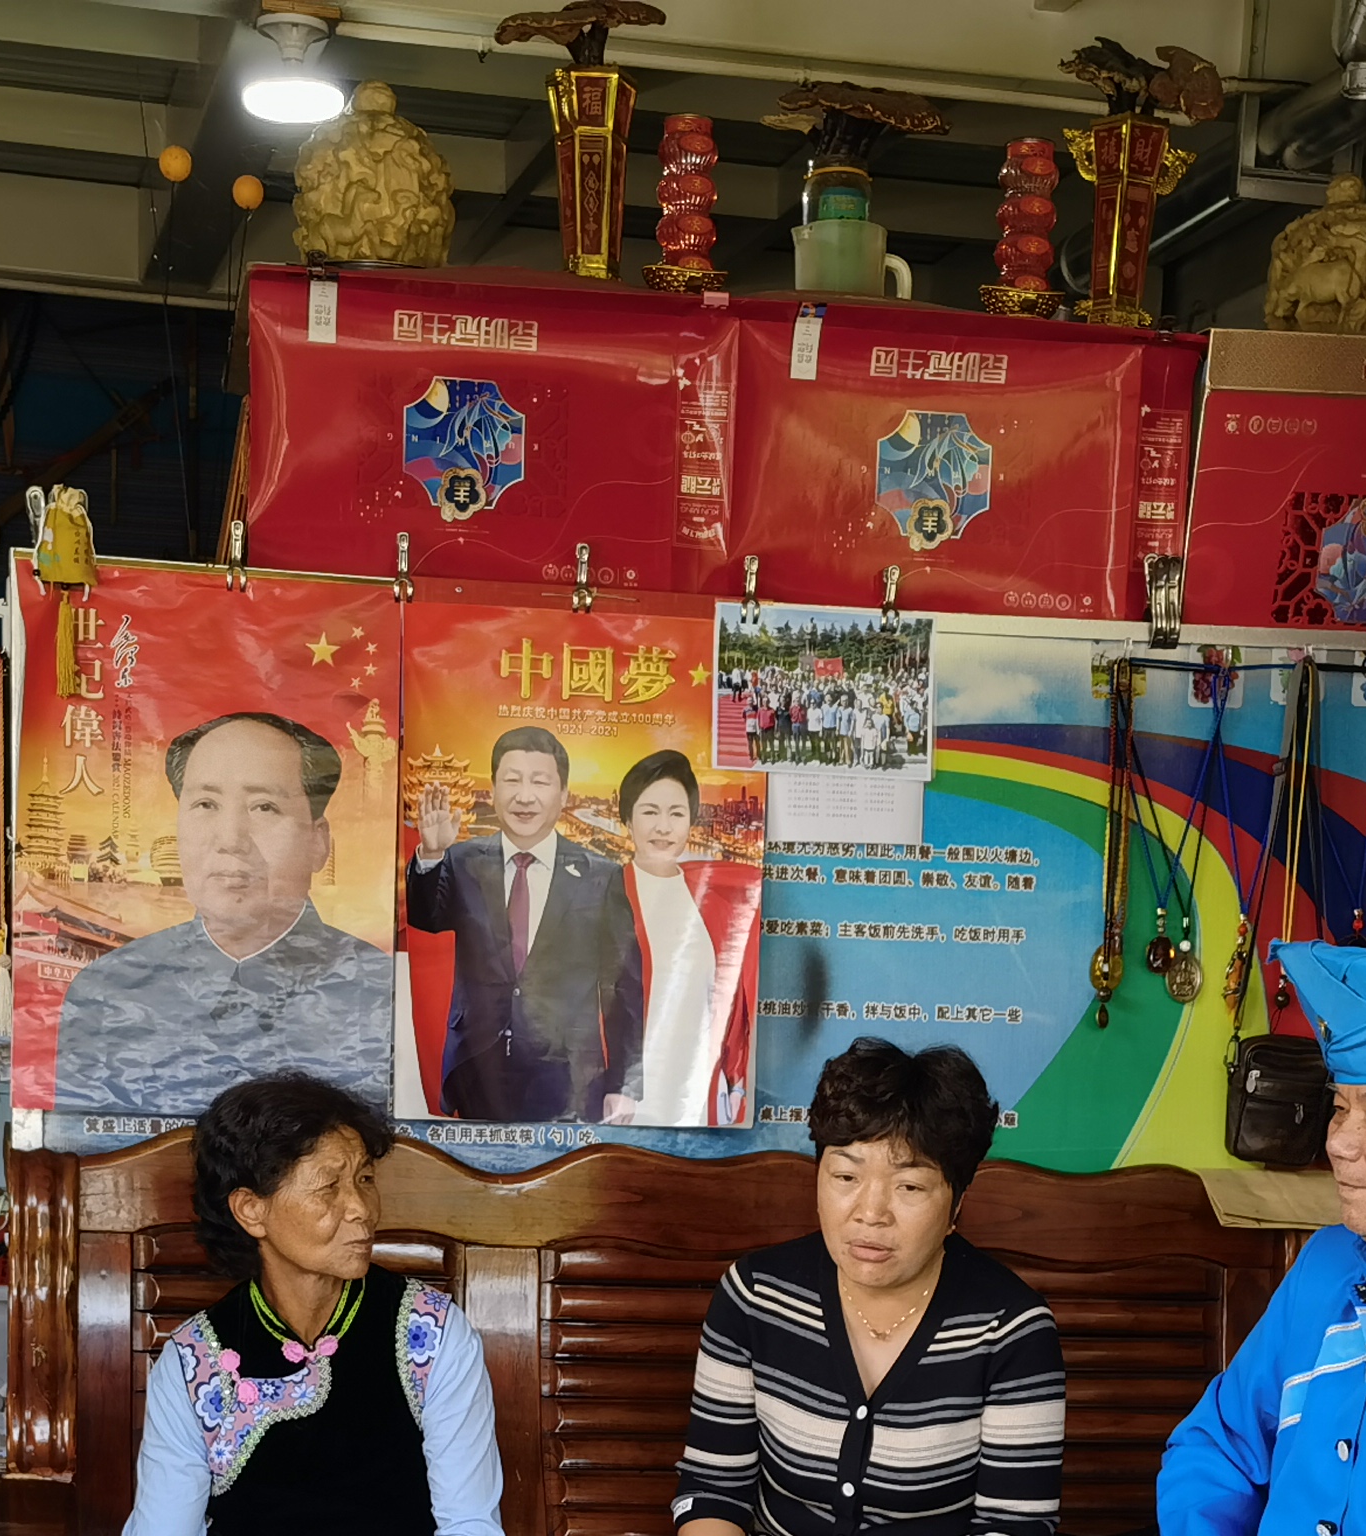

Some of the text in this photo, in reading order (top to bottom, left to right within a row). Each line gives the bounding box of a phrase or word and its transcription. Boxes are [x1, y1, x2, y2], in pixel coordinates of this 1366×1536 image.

[392, 309, 539, 352] 昆明冠生园
[869, 346, 1009, 385] 昆明冠生园
[499, 636, 678, 704] 中國夢
[556, 722, 619, 737] 1921-2021
